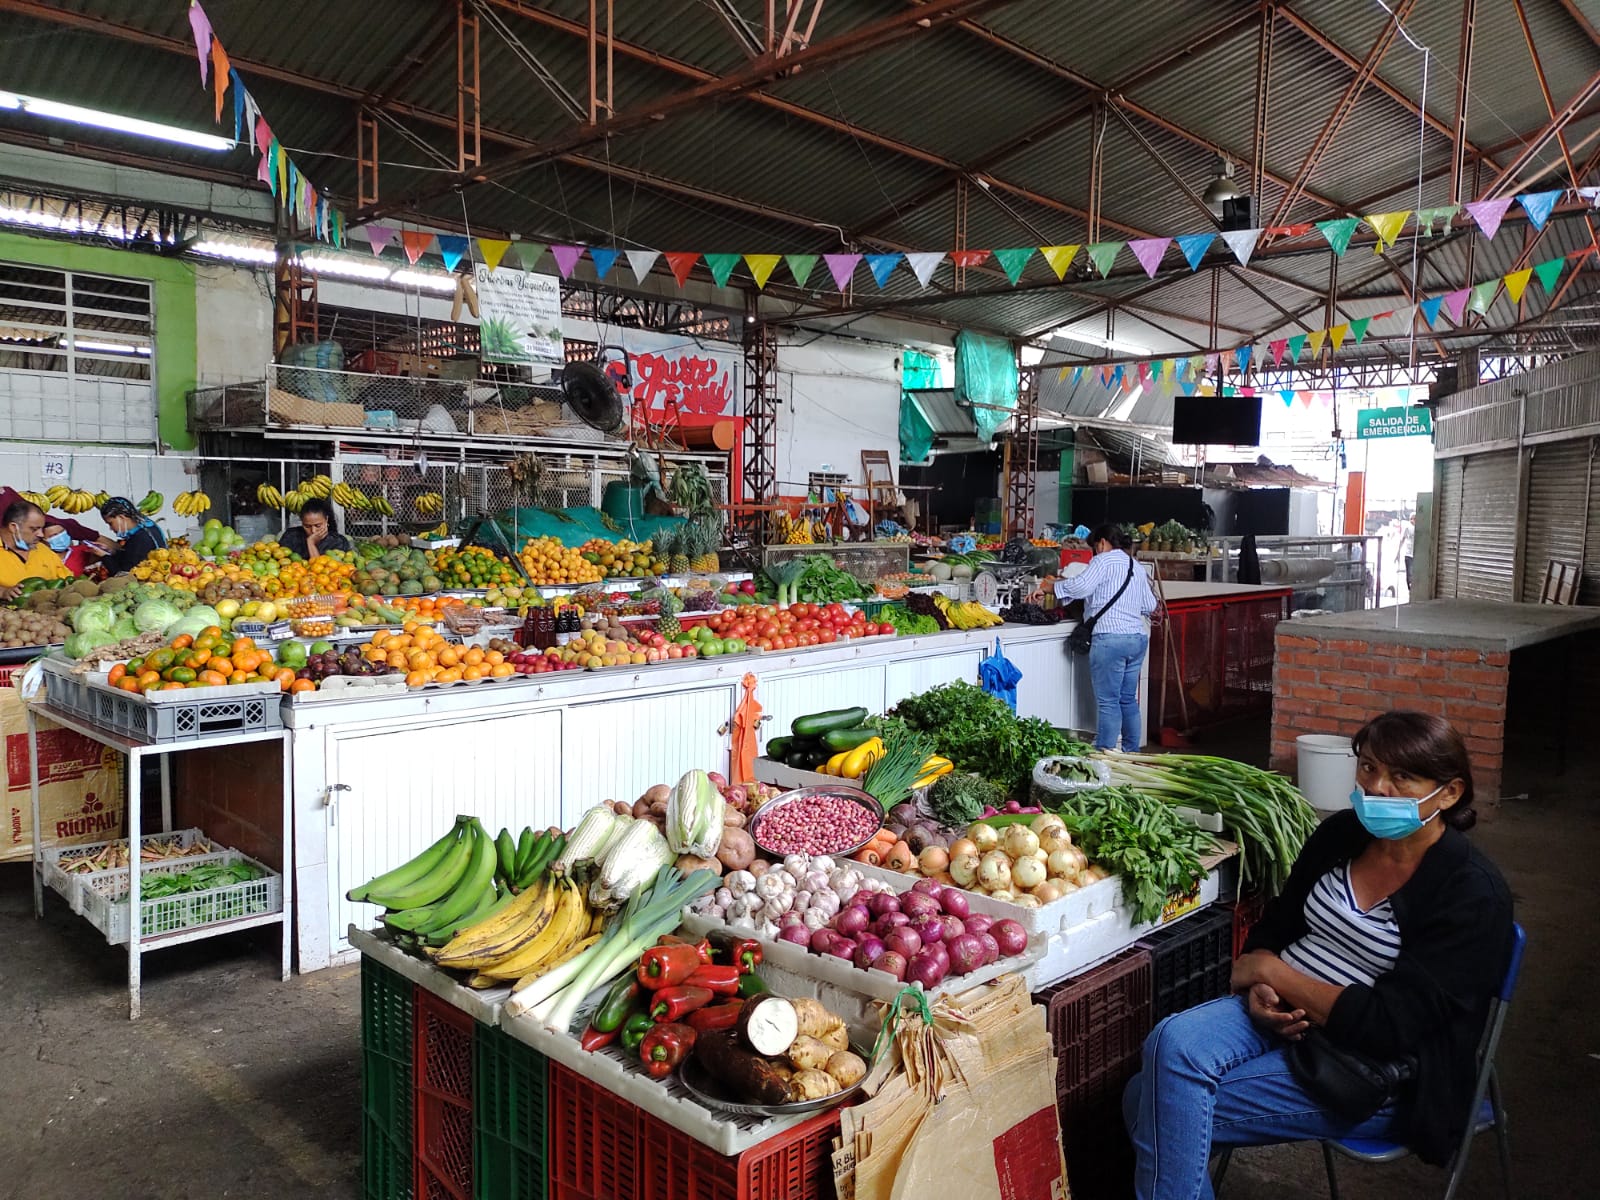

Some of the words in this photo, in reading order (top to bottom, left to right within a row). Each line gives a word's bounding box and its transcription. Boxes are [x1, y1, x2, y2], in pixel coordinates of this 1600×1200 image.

[1369, 416, 1403, 427] SALIDA
[1406, 415, 1419, 425] DE
[1363, 424, 1427, 436] EMERGENCIA
[45, 461, 64, 475] #3
